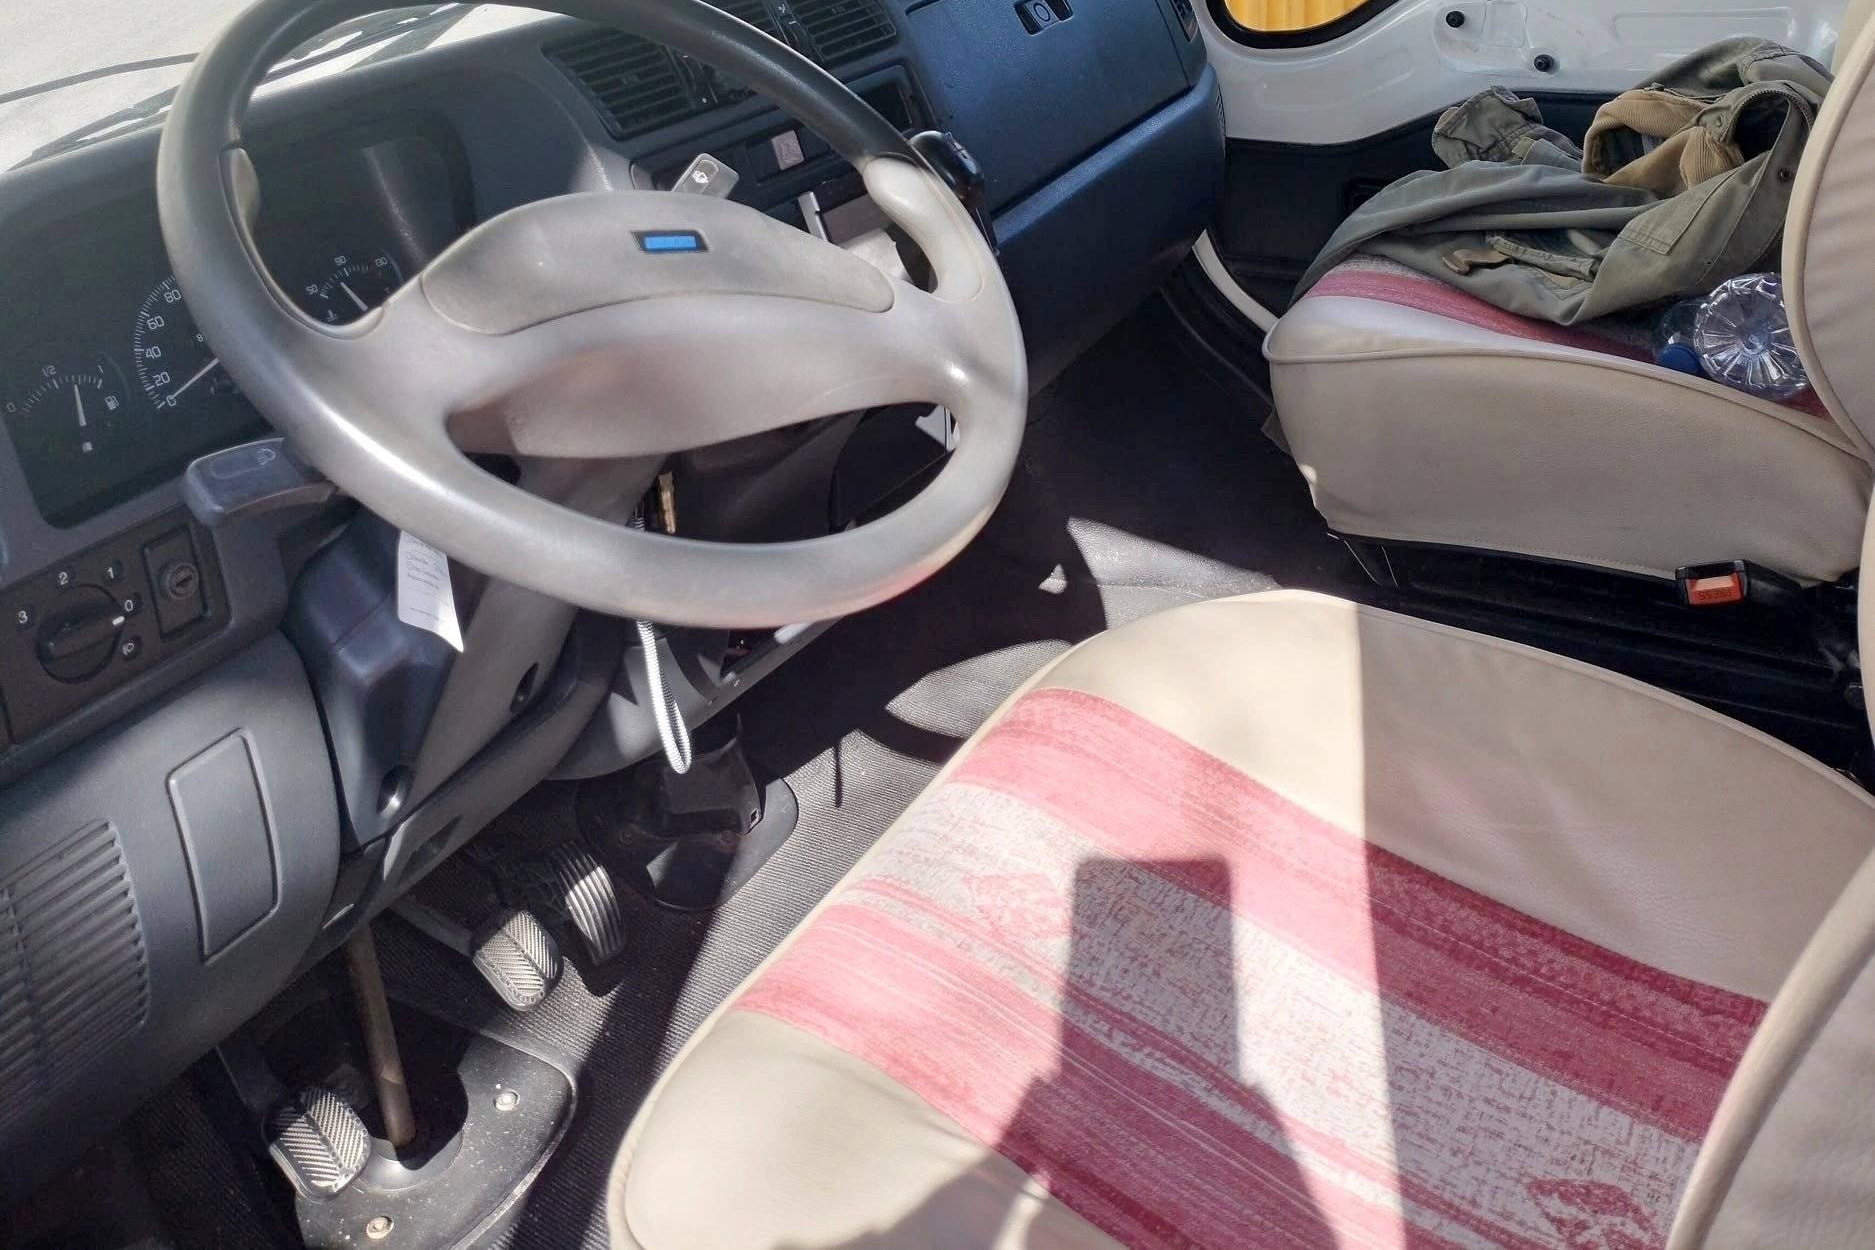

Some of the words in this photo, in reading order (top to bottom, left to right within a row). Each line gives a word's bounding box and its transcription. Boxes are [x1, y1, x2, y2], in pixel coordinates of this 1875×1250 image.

[164, 290, 181, 302] 80
[147, 316, 164, 329] 60
[146, 346, 161, 358] 40
[153, 372, 170, 386] 20
[58, 572, 68, 585] 2
[107, 567, 114, 579] 1
[19, 611, 28, 623] 3
